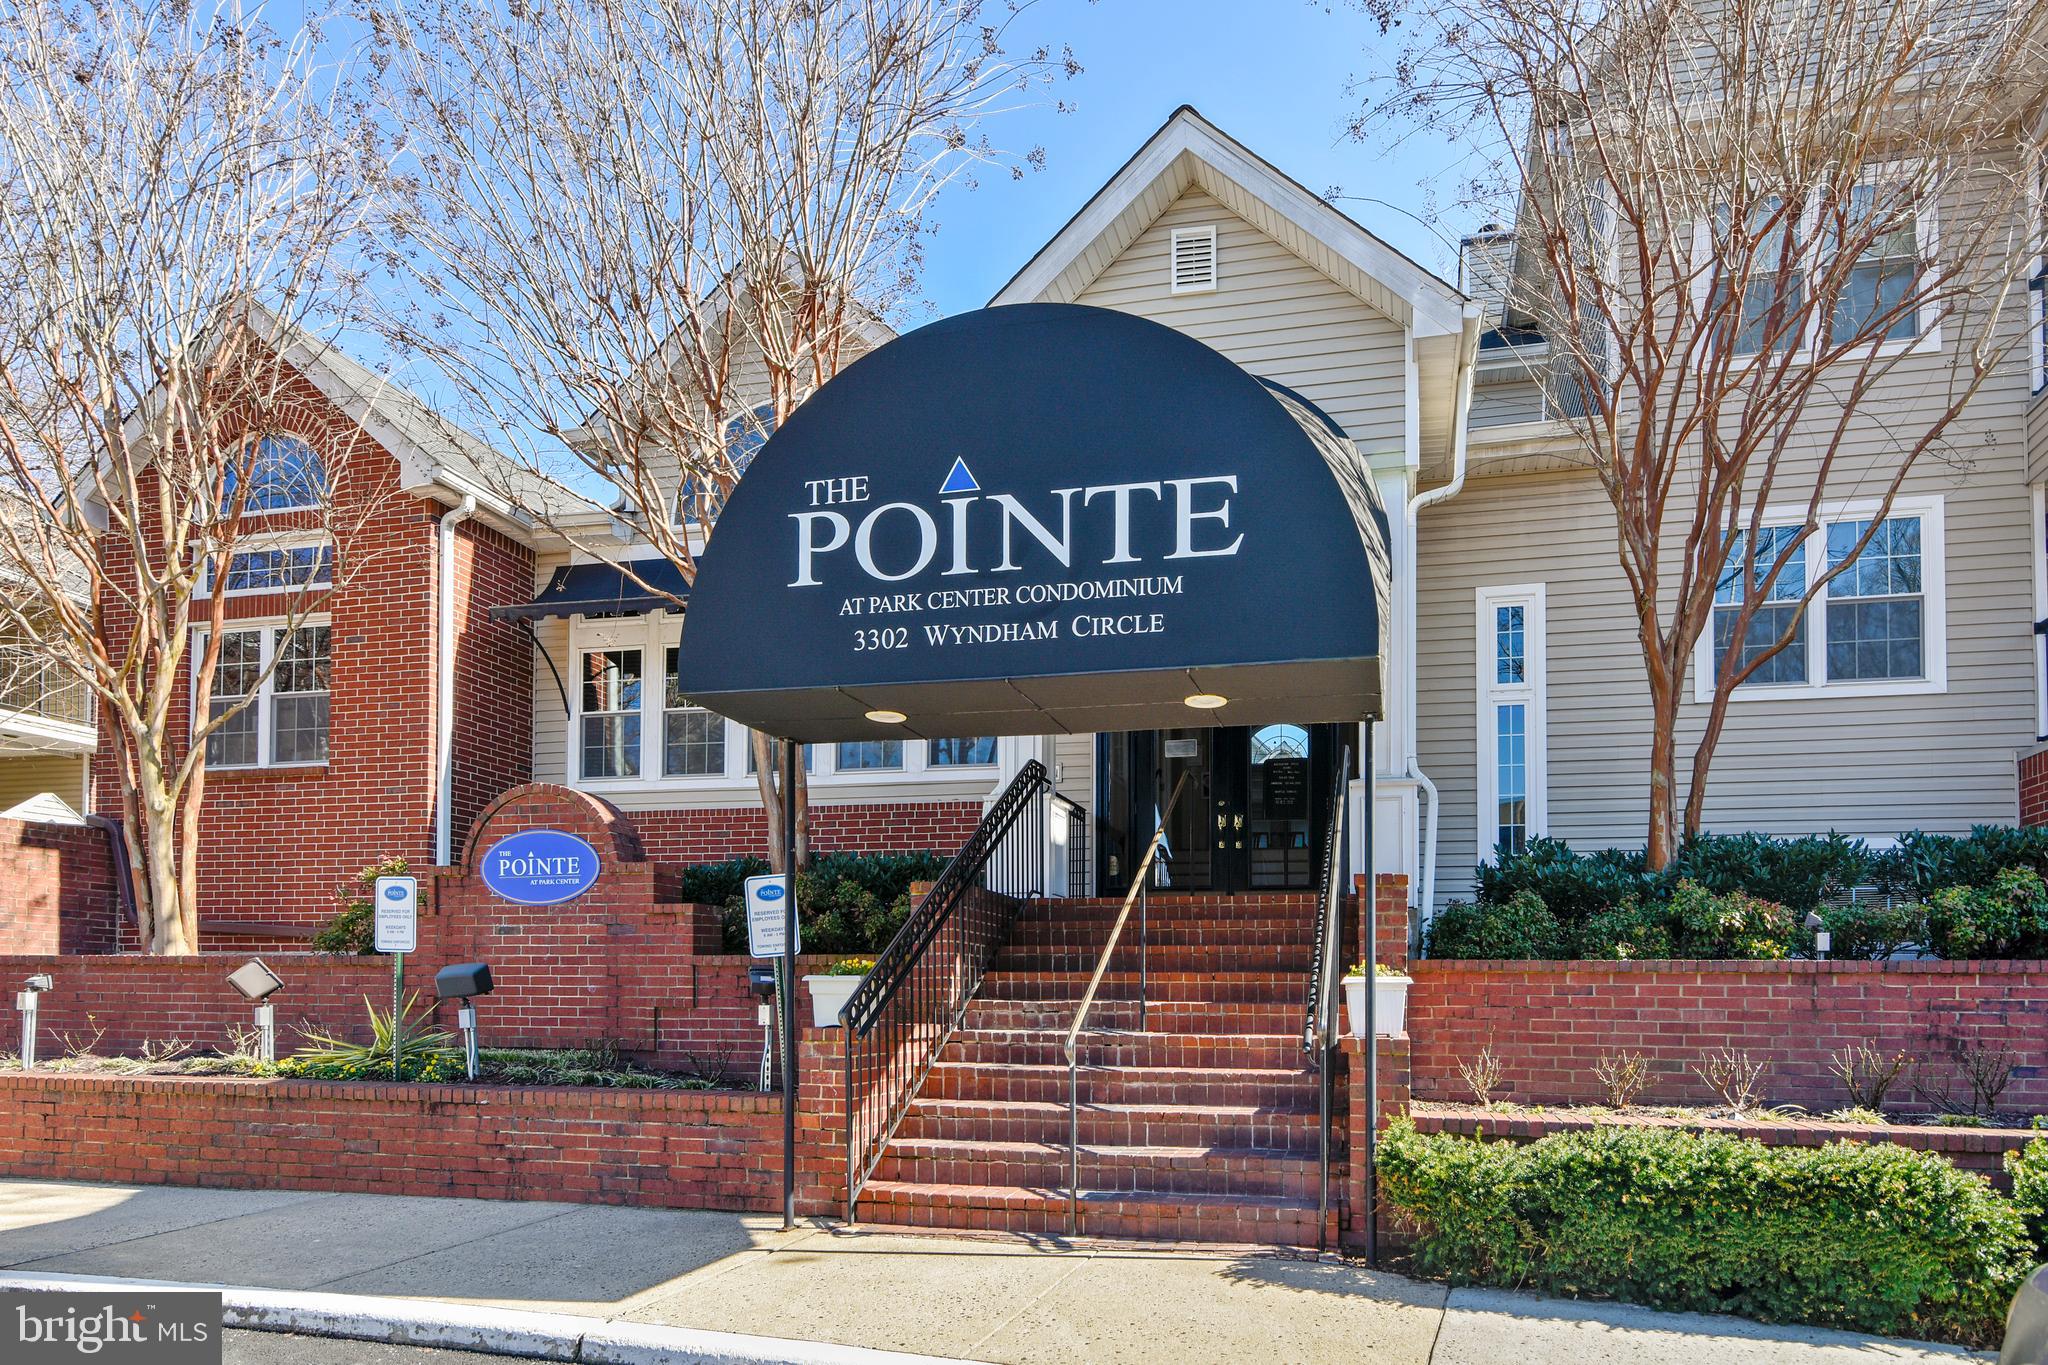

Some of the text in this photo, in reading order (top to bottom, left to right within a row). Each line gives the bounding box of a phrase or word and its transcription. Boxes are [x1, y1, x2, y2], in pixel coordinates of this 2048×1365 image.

[804, 475, 870, 506] THE
[787, 474, 1245, 588] POINTE
[839, 575, 1184, 616] AT PARK CENTER CONDOMINIUM
[853, 613, 1165, 651] 3302 WYNDHAM CIRCLE
[499, 856, 580, 876] POINTE
